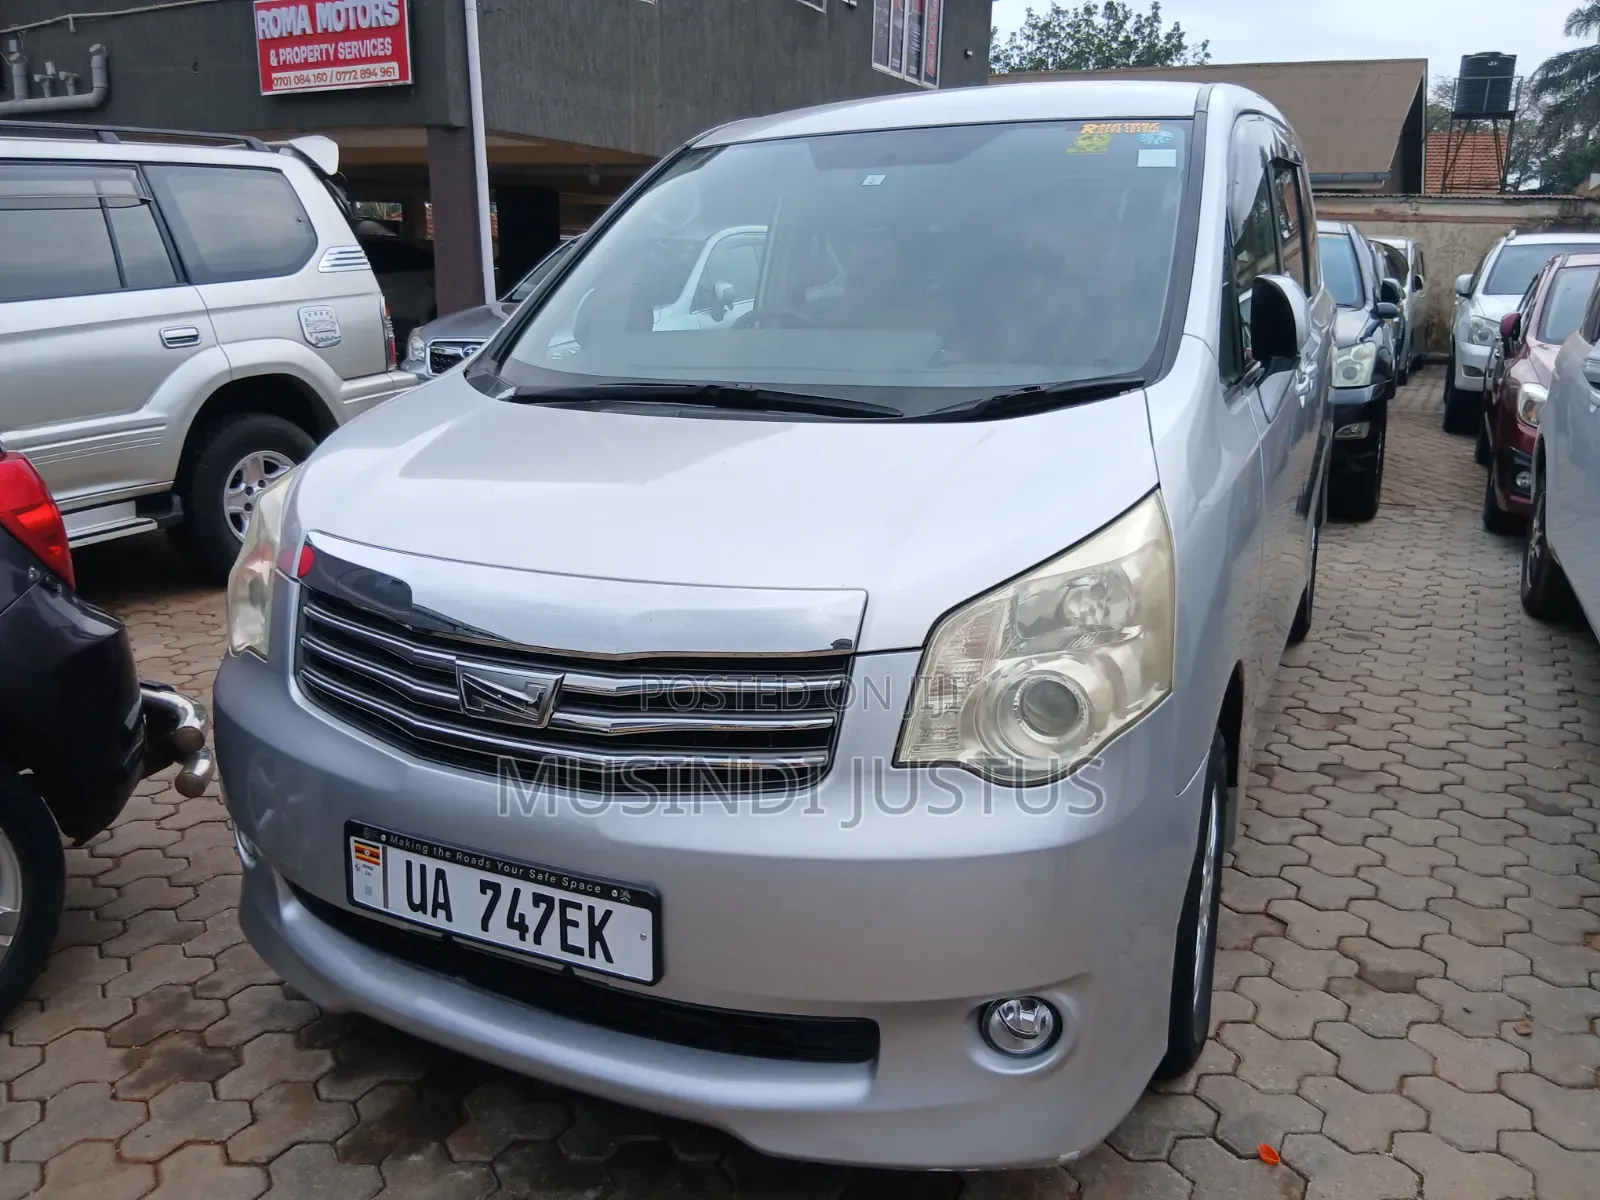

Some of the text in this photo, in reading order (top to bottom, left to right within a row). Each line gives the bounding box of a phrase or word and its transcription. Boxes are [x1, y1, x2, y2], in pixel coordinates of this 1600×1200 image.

[256, 0, 400, 40] ROMA MOTORS
[269, 37, 392, 67] & PROPERTY SERVICES
[272, 76, 292, 87] 0701
[293, 74, 311, 86] 084
[313, 72, 328, 83] 160
[335, 70, 358, 82] 0772
[360, 68, 378, 79] 894
[379, 66, 396, 78] 961
[389, 834, 601, 893] Making the Roads Your Safe Space
[405, 859, 614, 964] UA 747EK
